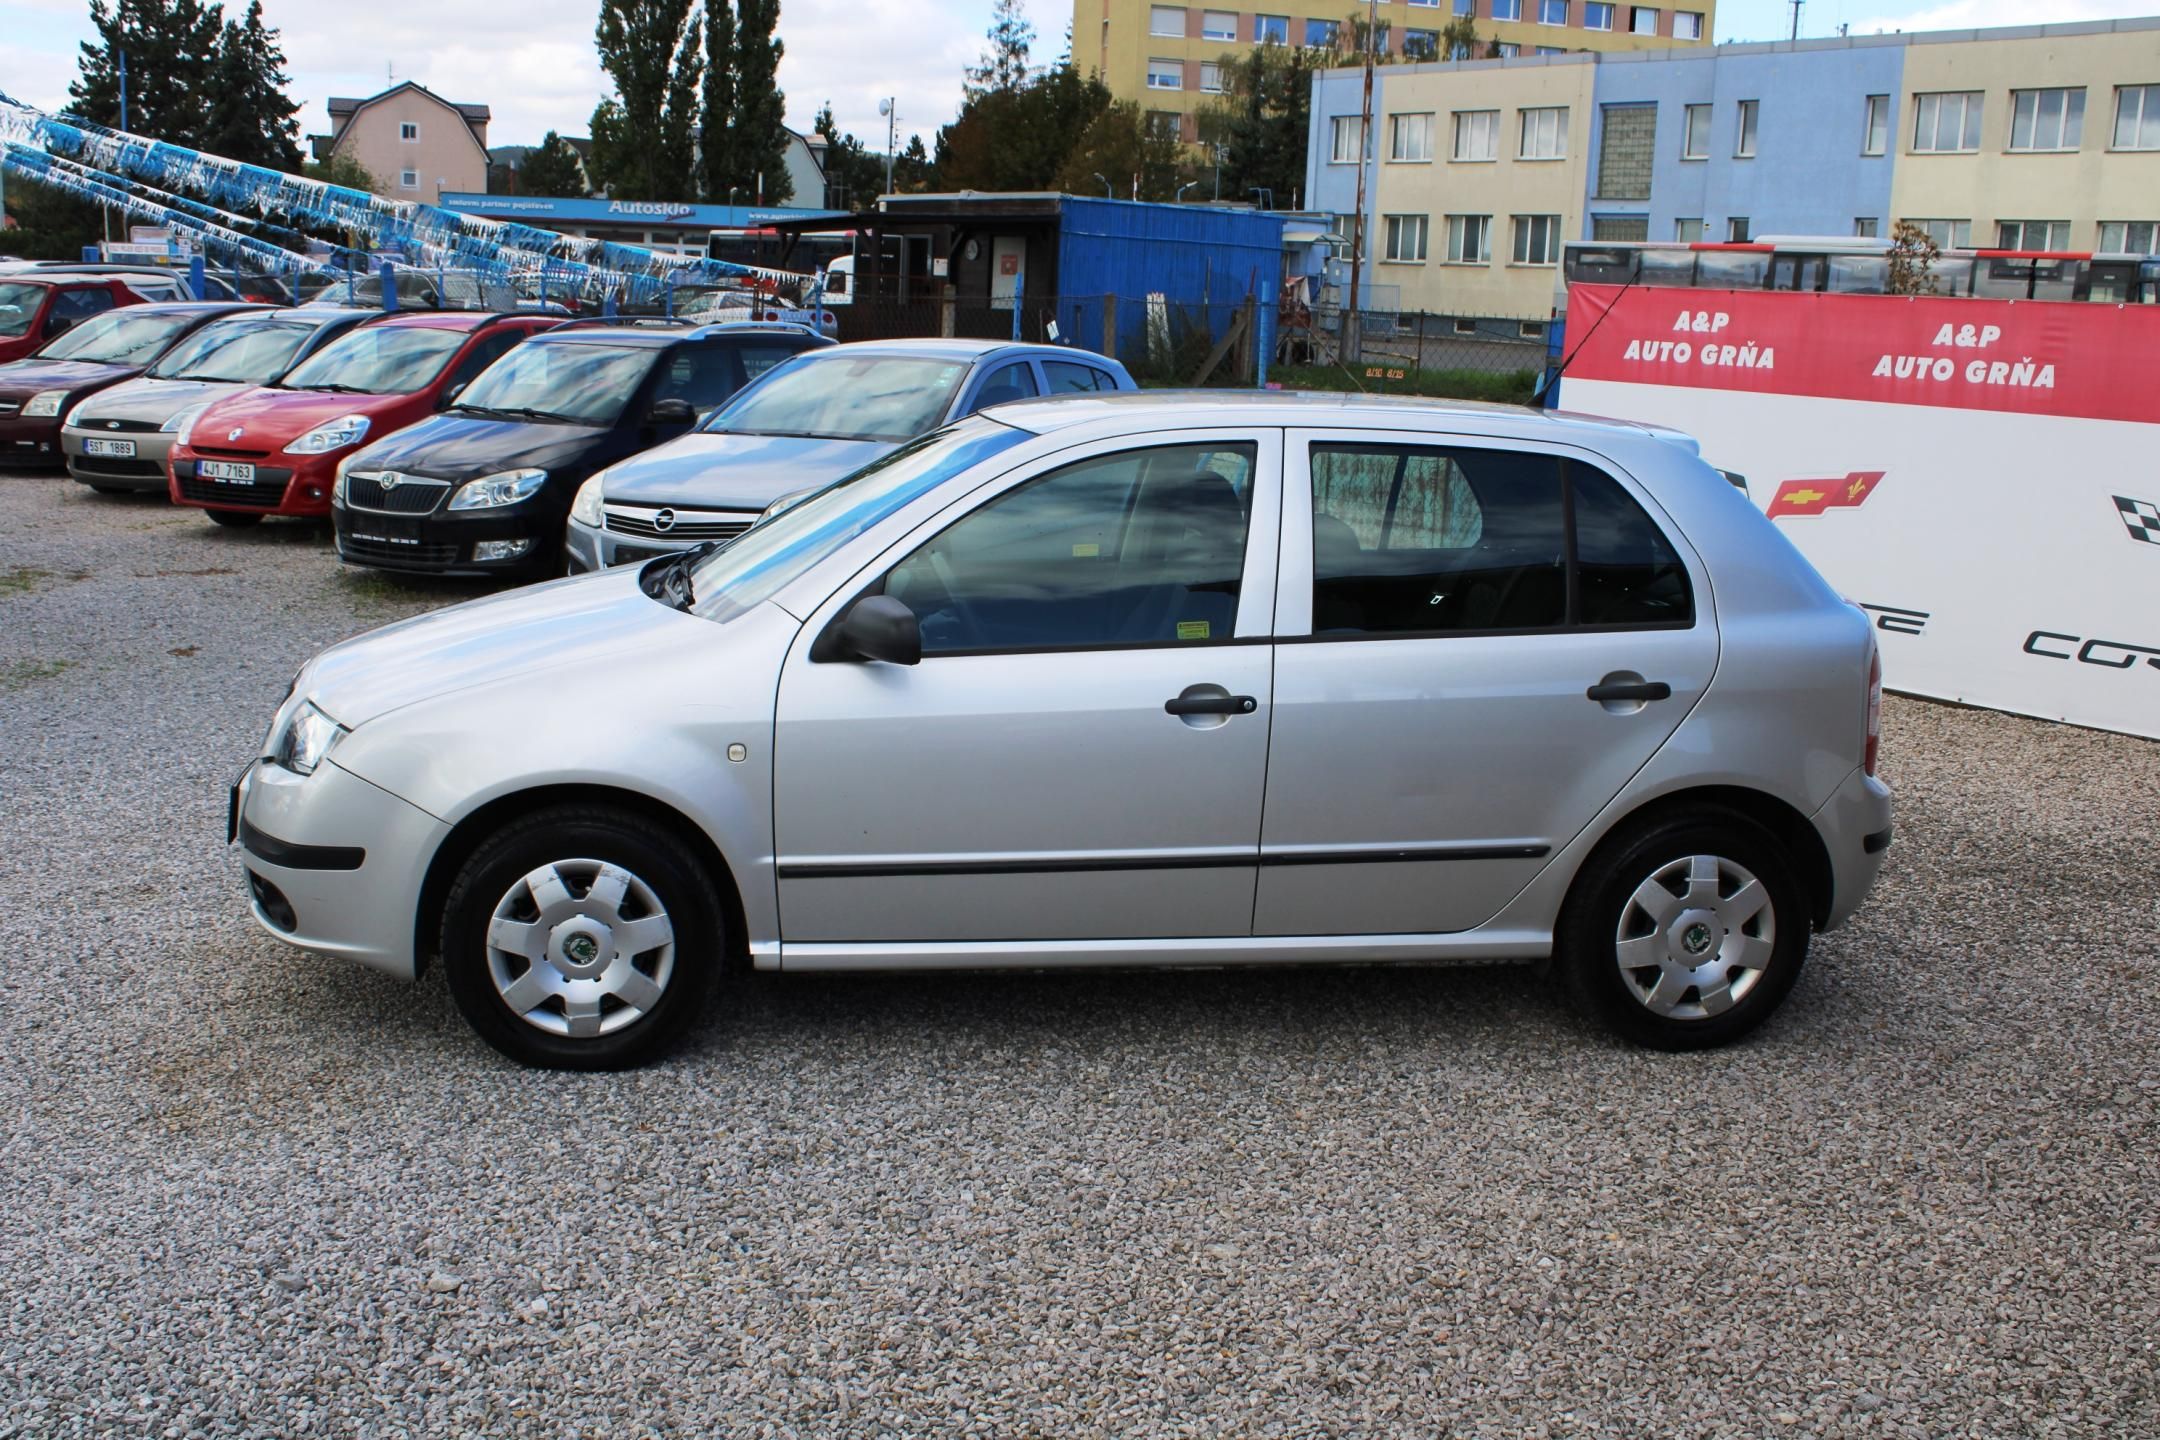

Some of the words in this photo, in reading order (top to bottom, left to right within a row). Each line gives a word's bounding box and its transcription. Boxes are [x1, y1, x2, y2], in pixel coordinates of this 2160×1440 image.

[608, 199, 690, 216] Autosklo
[1672, 310, 1730, 333] A&P
[1931, 322, 2001, 348] A&P
[1623, 339, 1692, 364] AUTO
[1700, 340, 1774, 369] GRŇA
[1871, 354, 1956, 382] AUTO
[1965, 356, 2056, 388] GRŇA
[89, 440, 105, 453] 5ST
[110, 442, 132, 455] 1889
[204, 462, 220, 476] 4J1
[226, 464, 250, 479] 7163
[2022, 630, 2160, 670] CO
